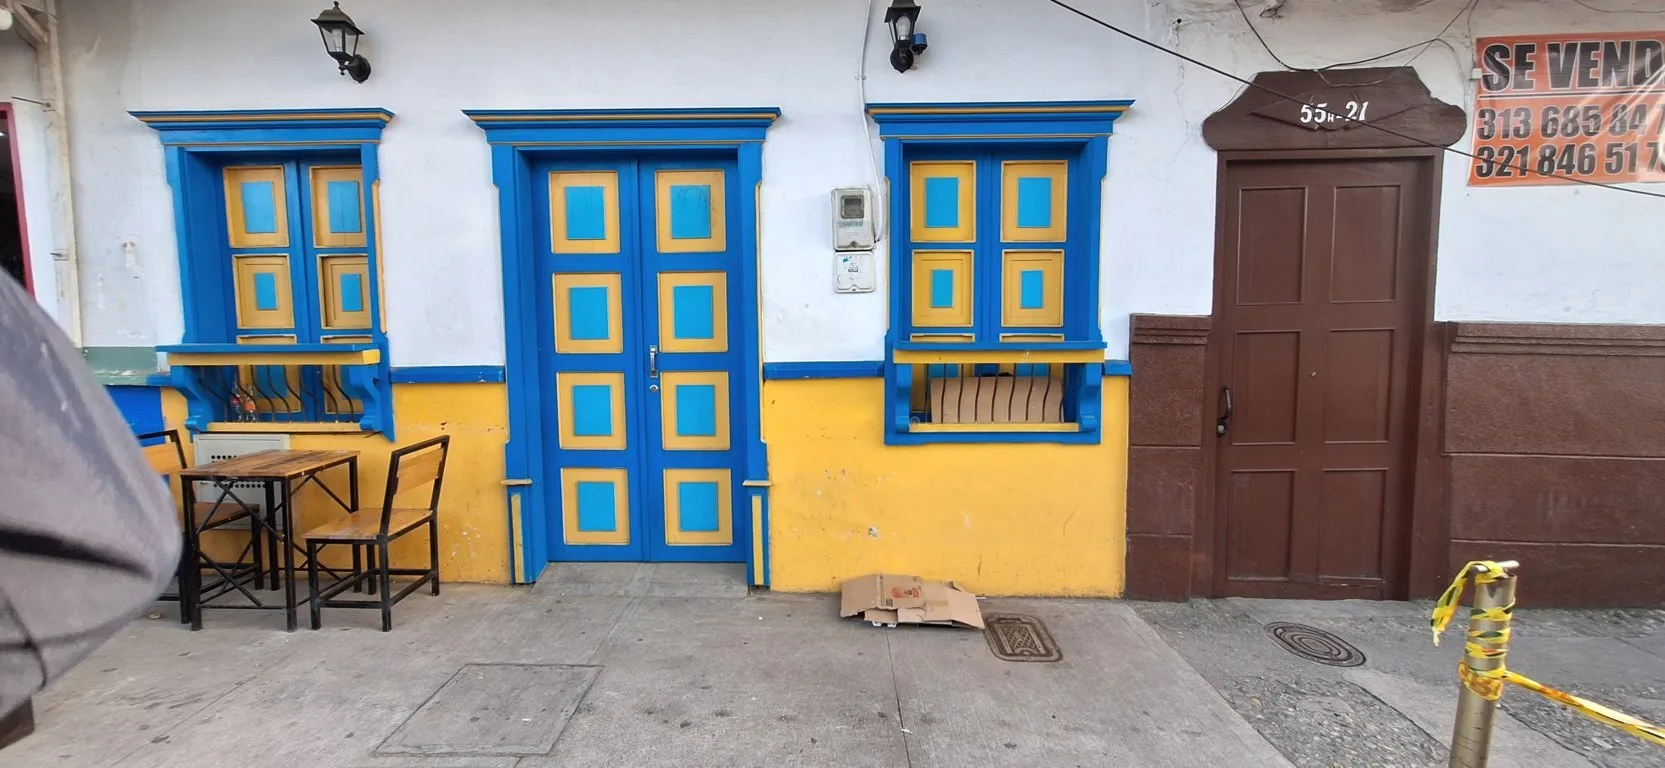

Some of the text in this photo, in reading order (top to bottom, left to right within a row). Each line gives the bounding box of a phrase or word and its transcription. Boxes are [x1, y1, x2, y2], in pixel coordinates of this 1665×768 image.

[1481, 43, 1536, 92] SE
[1477, 106, 1532, 141] 313
[1541, 104, 1602, 140] 685
[1608, 103, 1647, 137] 84
[1475, 145, 1530, 179] 321
[1536, 142, 1597, 177] 846
[1604, 141, 1637, 175] 51
